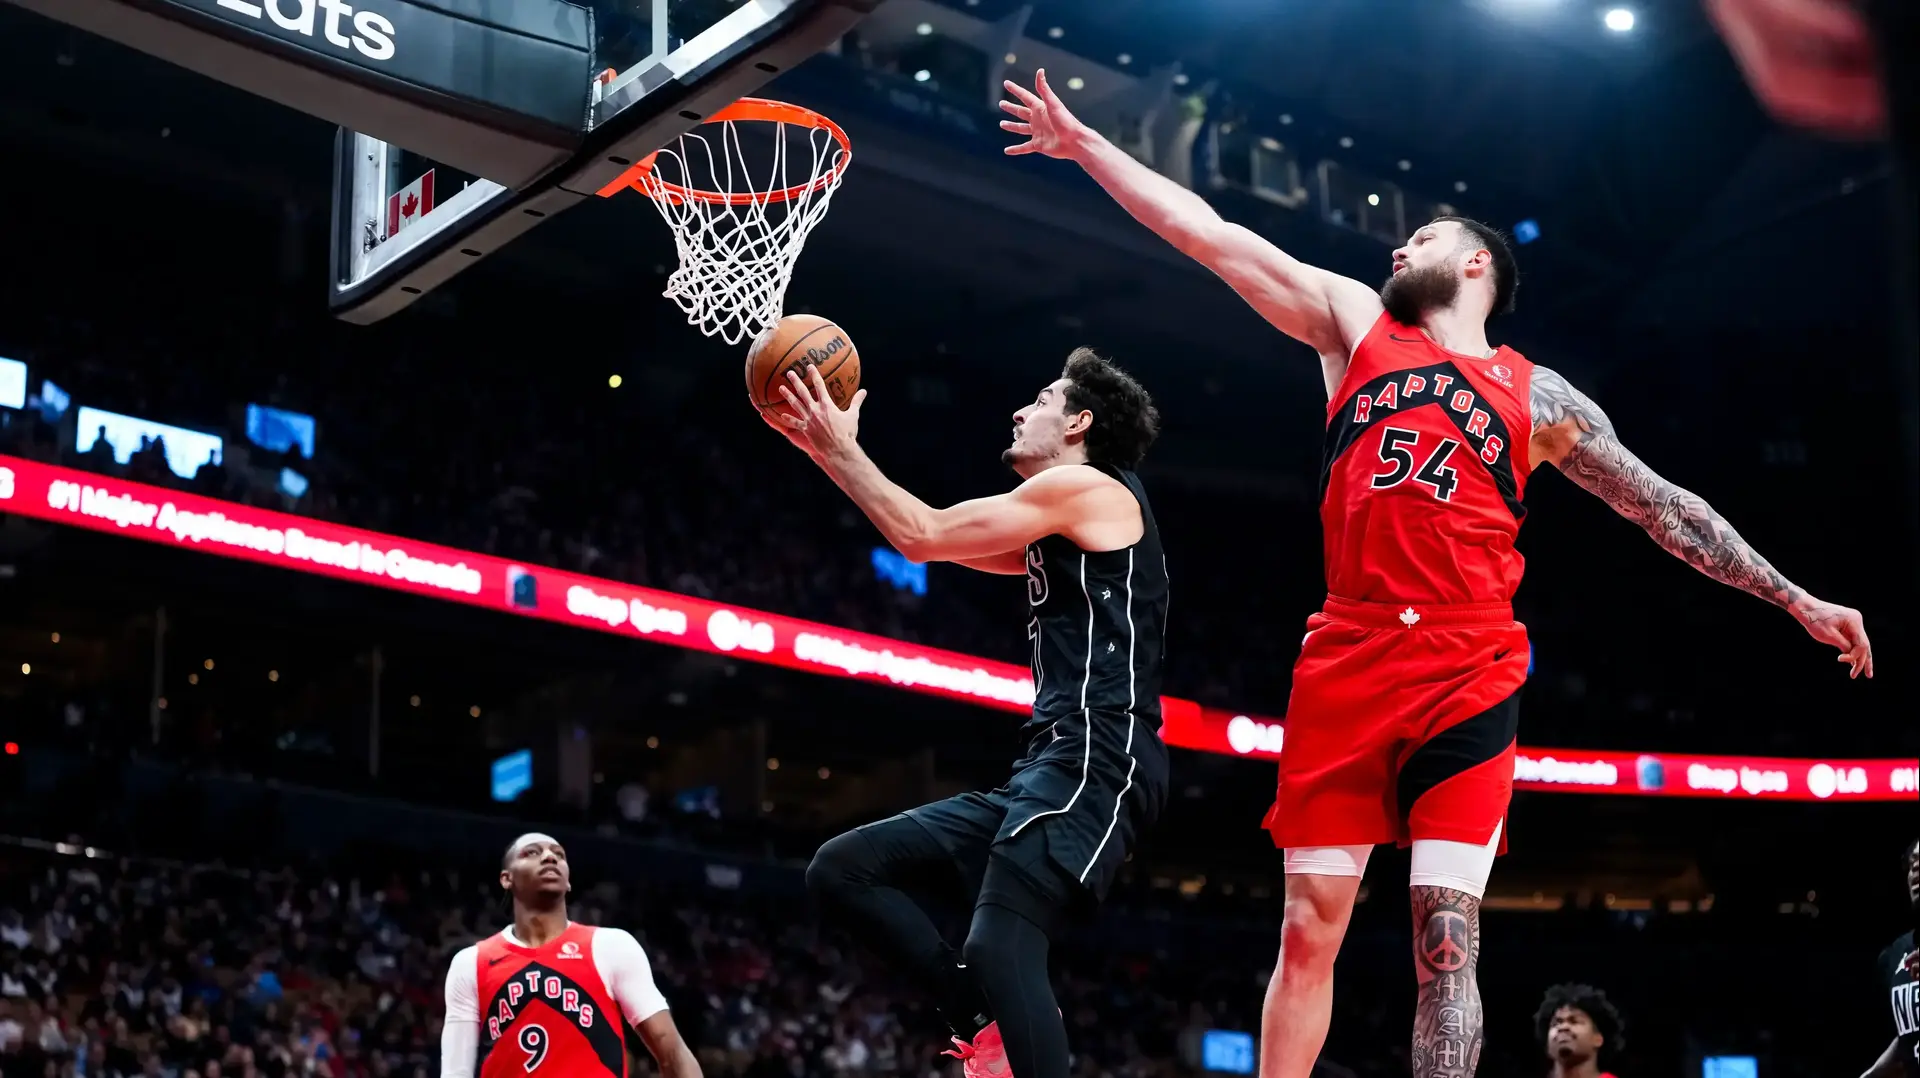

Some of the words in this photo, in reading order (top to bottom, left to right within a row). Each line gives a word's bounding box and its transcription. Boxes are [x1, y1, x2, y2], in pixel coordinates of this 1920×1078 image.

[1353, 372, 1504, 465] RAPTORS
[1370, 425, 1461, 503] 54
[81, 486, 158, 528] Major
[157, 502, 284, 554] Appliance
[285, 528, 360, 570] Brand
[386, 549, 482, 594] Canada
[488, 970, 594, 1040] RAPTORS
[517, 1023, 549, 1073] 9
